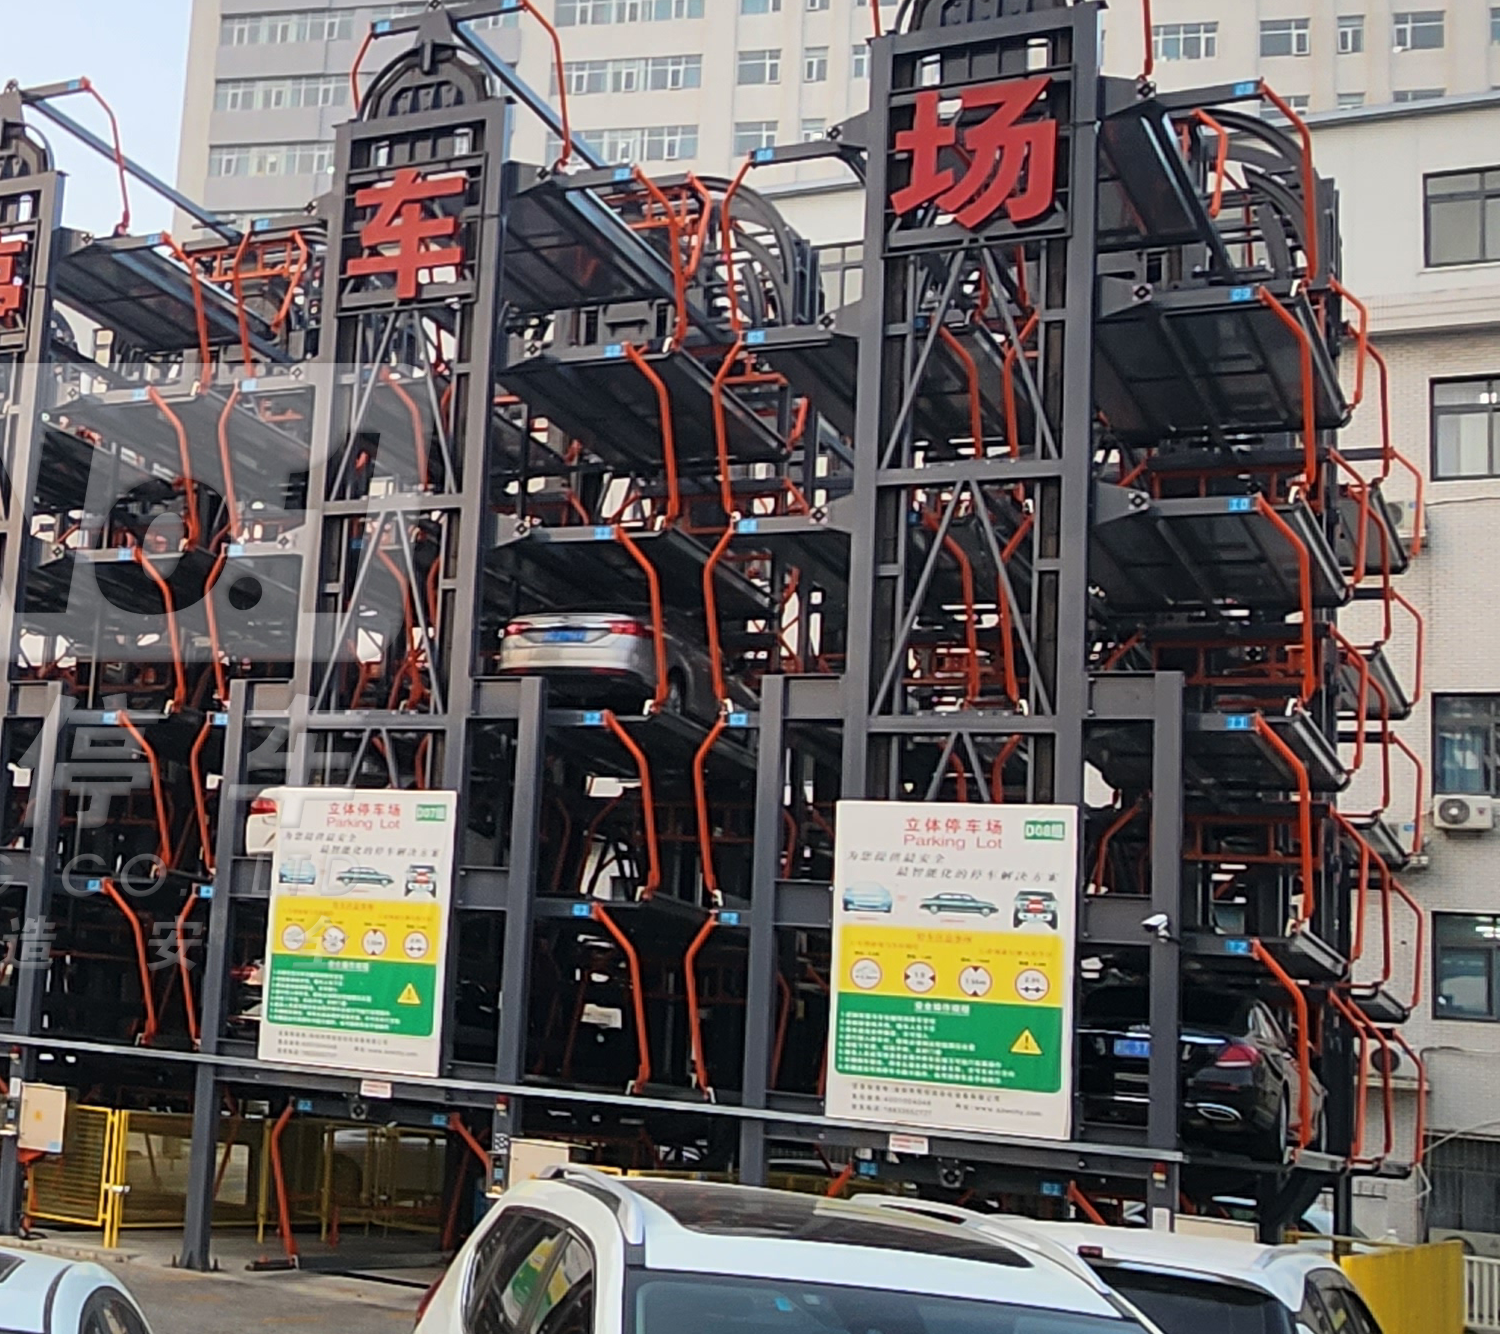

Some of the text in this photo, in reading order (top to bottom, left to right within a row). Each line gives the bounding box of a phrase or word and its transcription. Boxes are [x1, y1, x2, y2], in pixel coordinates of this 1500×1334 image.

[347, 168, 466, 299] 车
[890, 76, 1057, 229] 场
[326, 816, 401, 830] Parking Lot
[904, 817, 1003, 836] 立体停车场
[903, 833, 1003, 850] Parking Lot
